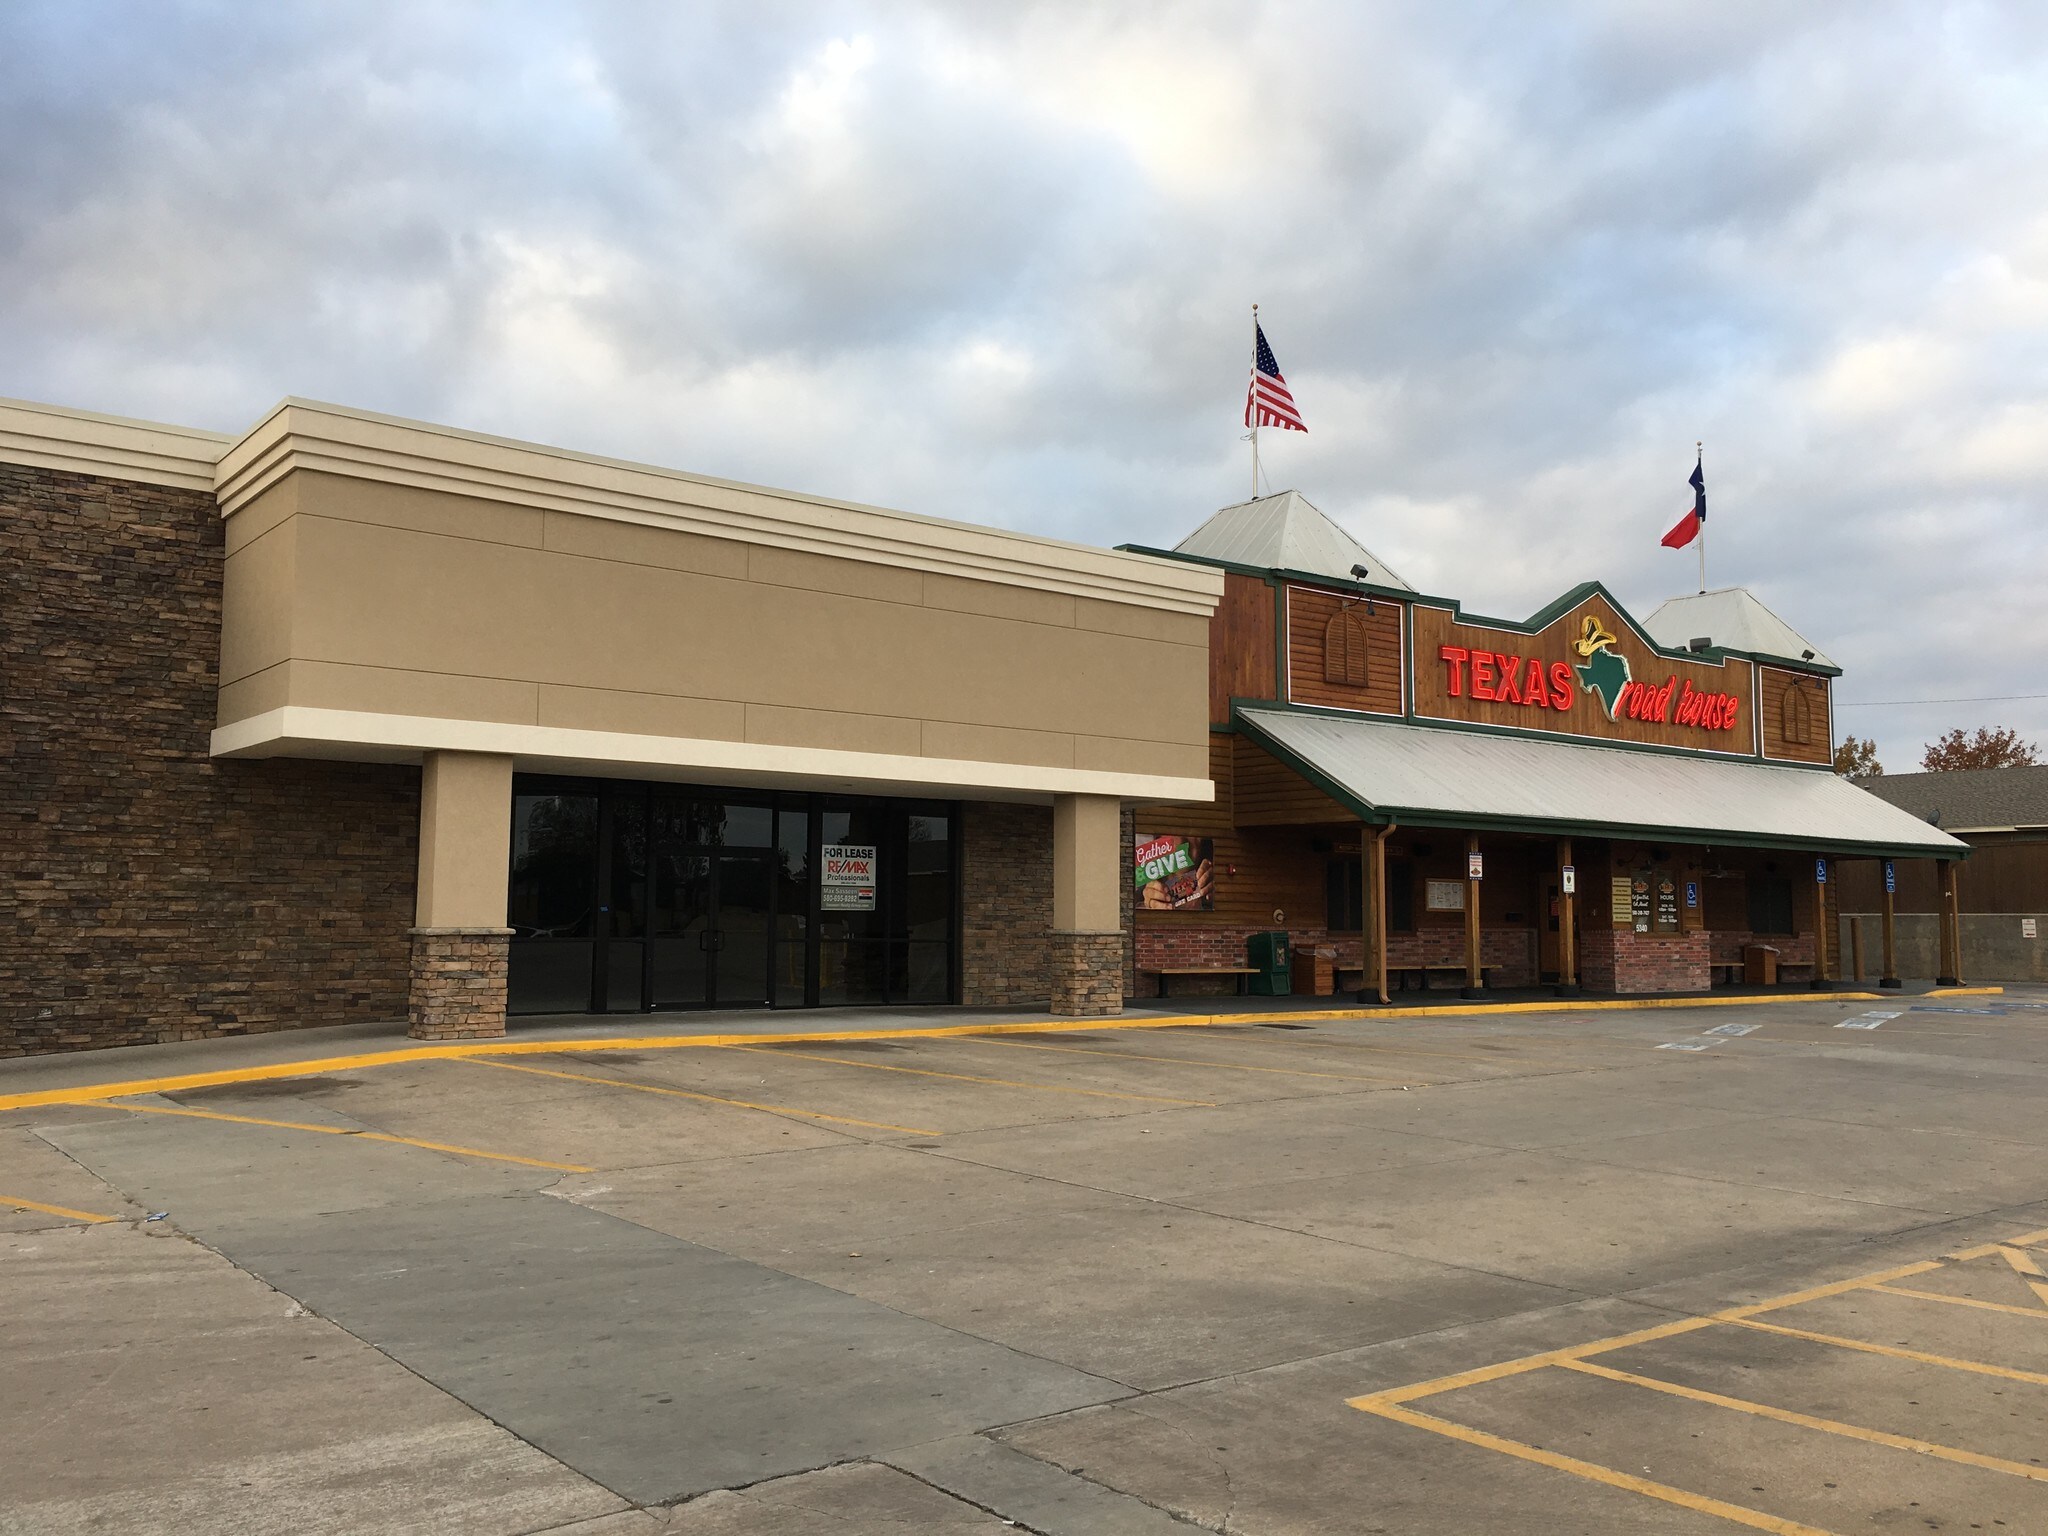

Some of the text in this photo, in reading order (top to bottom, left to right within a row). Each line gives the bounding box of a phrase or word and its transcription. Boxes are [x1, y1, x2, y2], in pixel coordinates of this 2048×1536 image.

[1440, 646, 1574, 711] TEXAS
[824, 848, 873, 859] FOR LEASE
[1136, 841, 1173, 868] Gather
[1145, 849, 1189, 880] GIVE
[827, 873, 870, 881] Professionals
